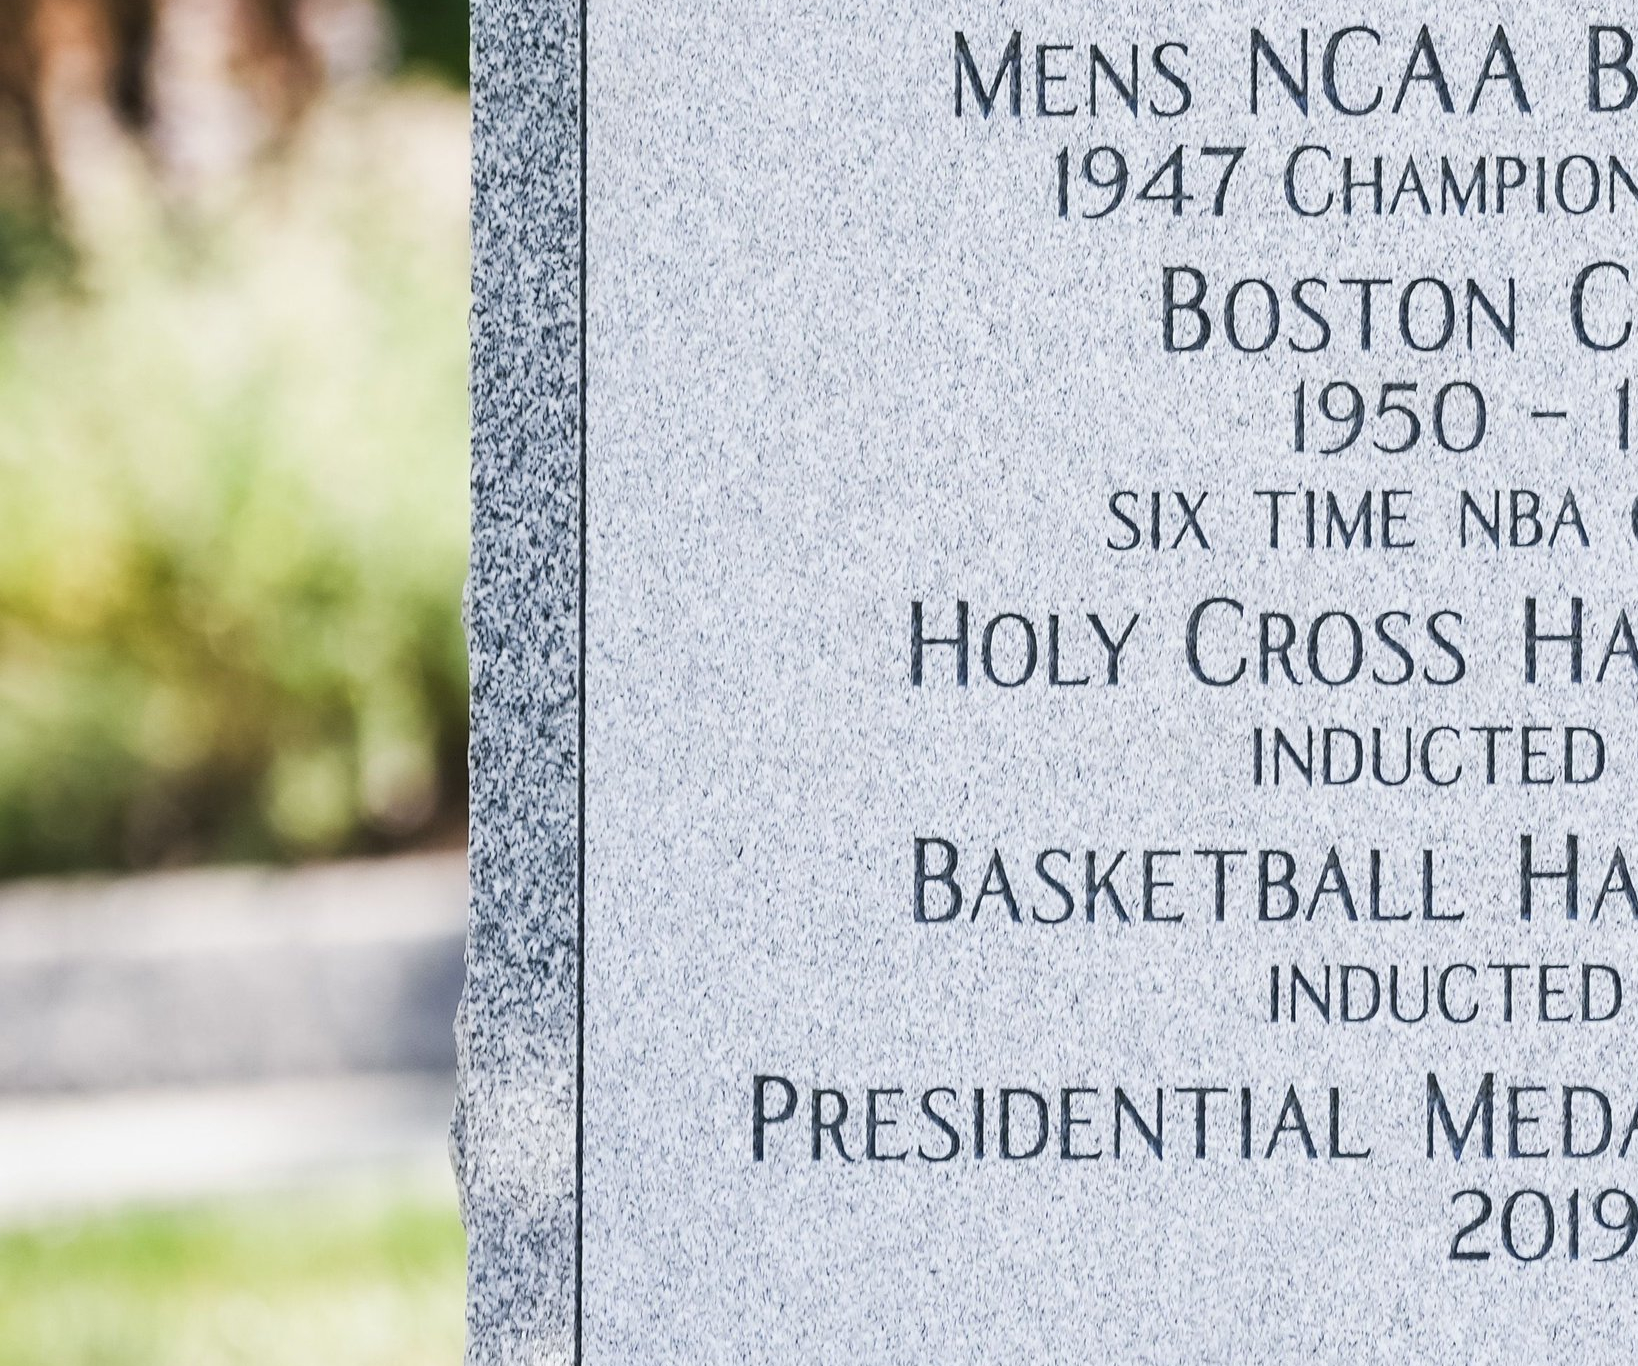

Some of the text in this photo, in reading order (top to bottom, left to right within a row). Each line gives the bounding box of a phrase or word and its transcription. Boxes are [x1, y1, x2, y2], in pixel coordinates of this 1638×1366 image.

[1249, 24, 1532, 117] NCAA
[1056, 144, 1246, 220] 1947
[1294, 380, 1487, 456] 1950
[1106, 490, 1210, 551] SIX
[1254, 488, 1416, 550] TIME
[1459, 488, 1590, 548] NBA
[1253, 725, 1606, 787] INDUCTED
[1270, 962, 1624, 1025] INDUCTED
